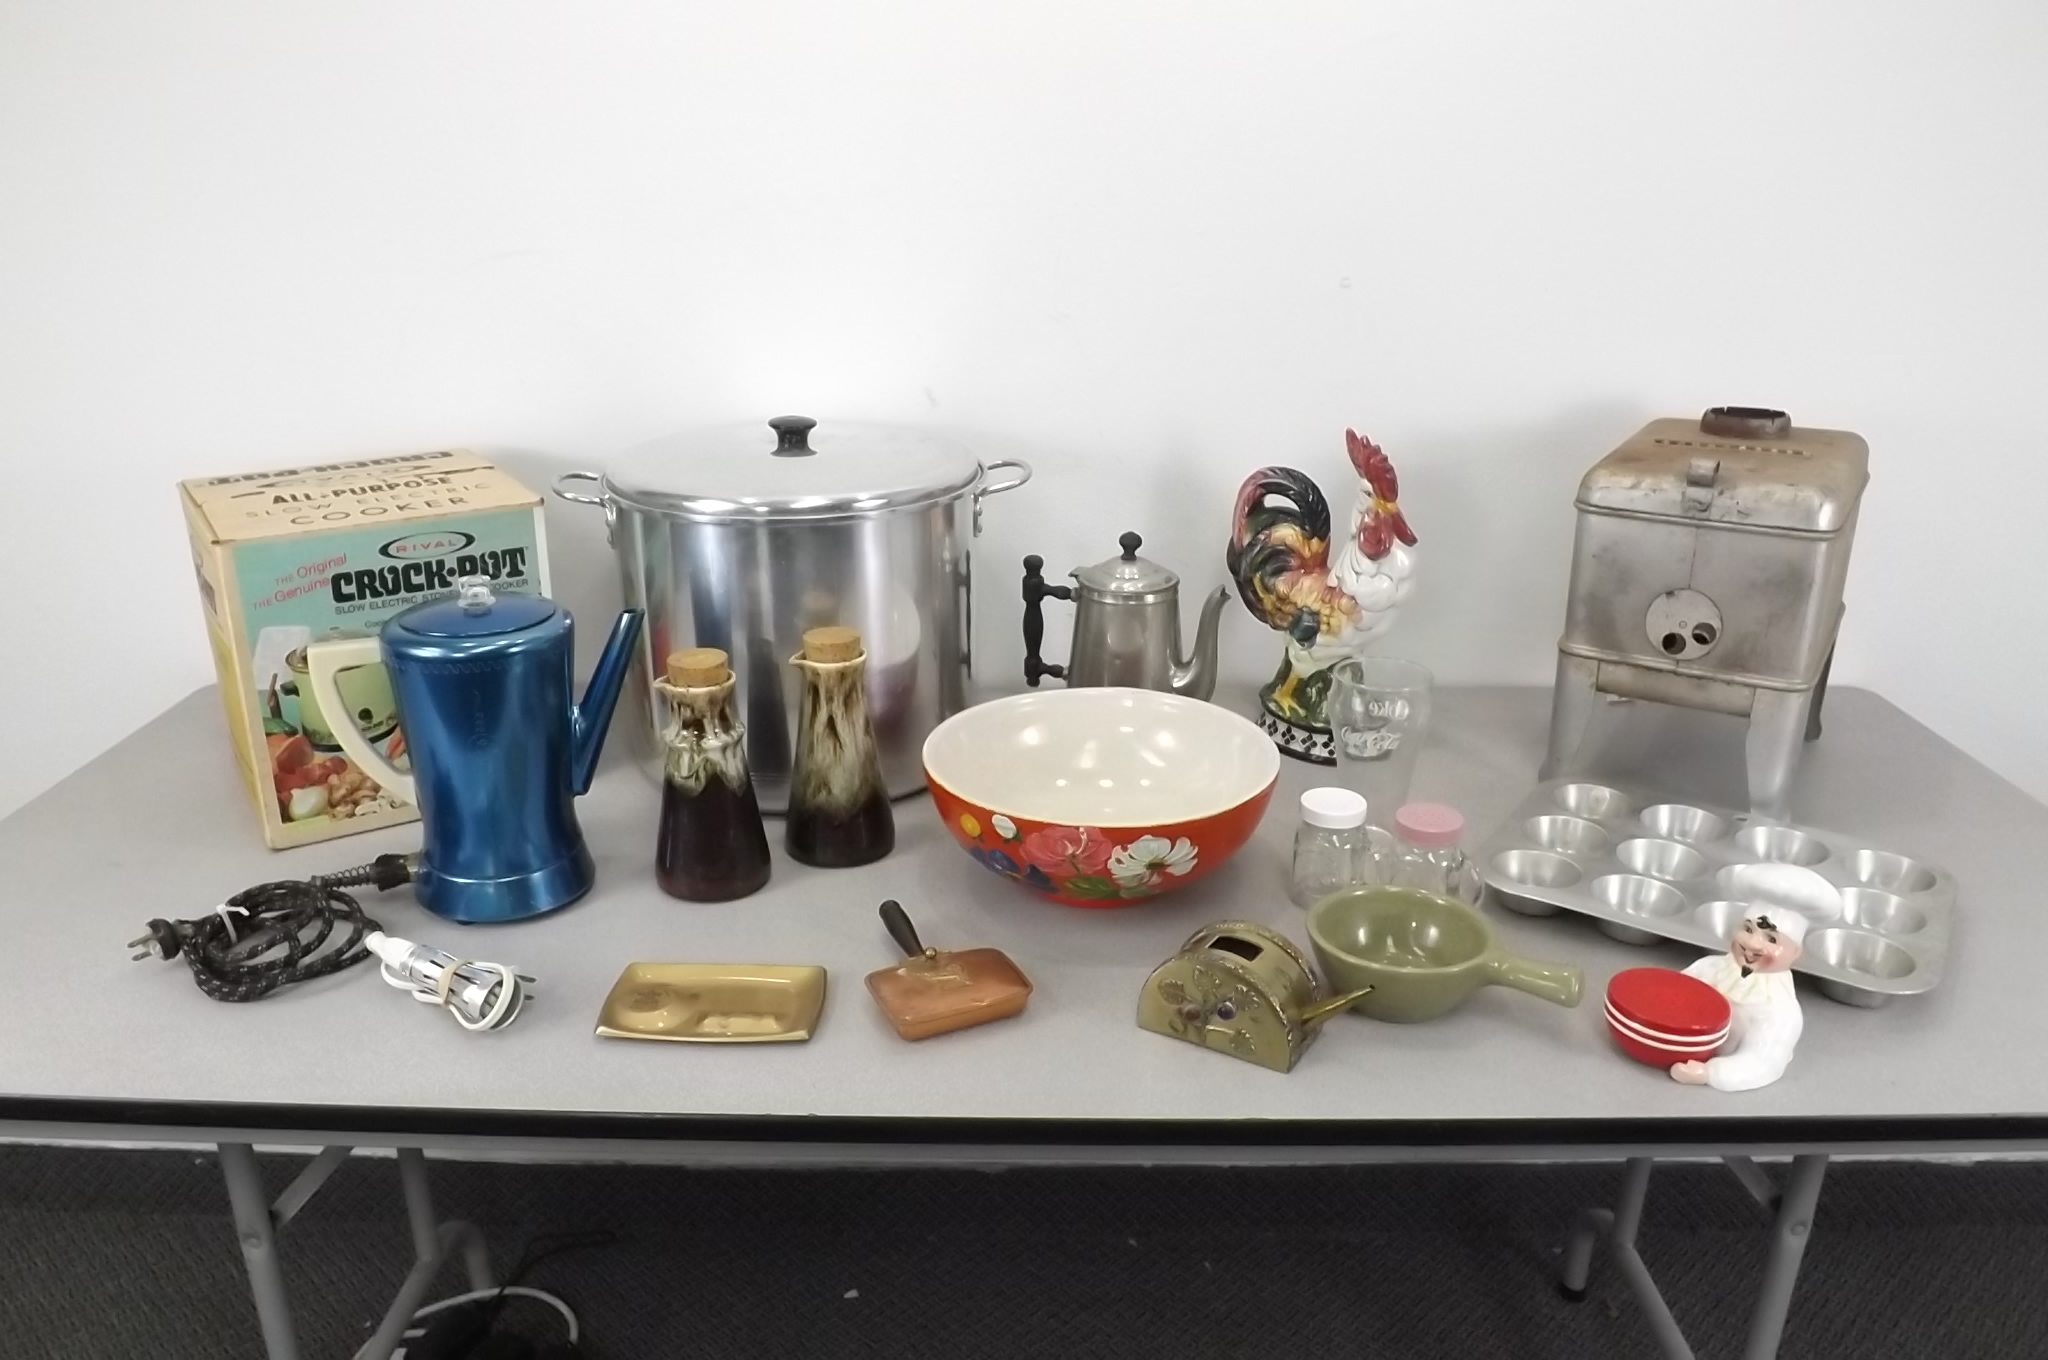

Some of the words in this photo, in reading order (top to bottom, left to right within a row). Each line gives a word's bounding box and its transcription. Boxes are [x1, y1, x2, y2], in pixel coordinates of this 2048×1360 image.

[290, 496, 469, 525] COOKER
[395, 539, 458, 554] RIVAL
[274, 573, 295, 587] THE
[296, 552, 347, 579] Original
[252, 597, 274, 611] THE
[274, 577, 331, 603] Genuine
[334, 603, 366, 616] SLOW
[368, 595, 418, 611] ELECTRIC
